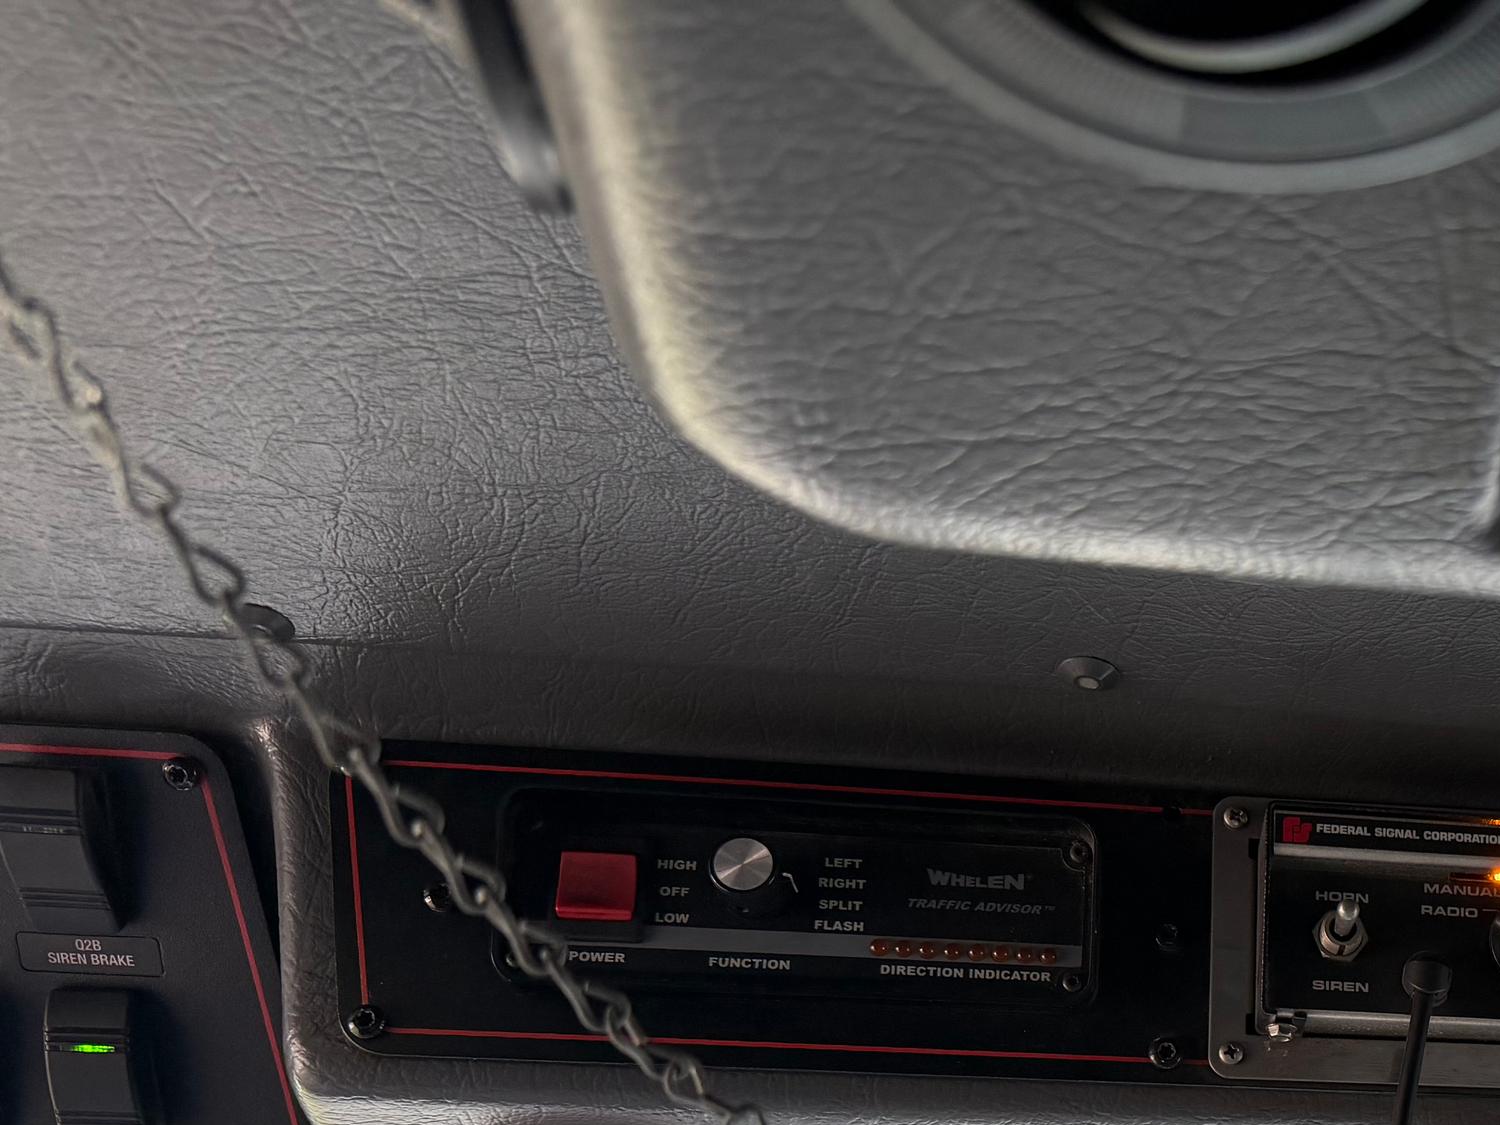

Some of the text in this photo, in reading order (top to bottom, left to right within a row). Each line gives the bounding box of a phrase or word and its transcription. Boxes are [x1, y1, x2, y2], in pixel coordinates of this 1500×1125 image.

[1316, 823, 1371, 837] FEDERAL
[1374, 828, 1420, 840] SIGNAL
[657, 859, 697, 871] HIGH
[825, 857, 863, 869] LEFT
[818, 877, 867, 890] RIGHT
[659, 886, 690, 897] OFF
[1315, 890, 1369, 904] HORN
[818, 899, 863, 911] SPLIT
[907, 898, 971, 912] TRAFFIC
[1421, 904, 1479, 918] RADIO
[655, 912, 690, 924] LOW
[814, 920, 864, 932] FLASH
[75, 939, 102, 951] Q2B
[47, 952, 135, 967] SIREN BRAKE
[568, 951, 626, 963] POWER
[708, 957, 791, 970] FUNCTION
[880, 965, 1051, 982] DIRECTION INDICATOR
[1312, 980, 1369, 993] SIREN
